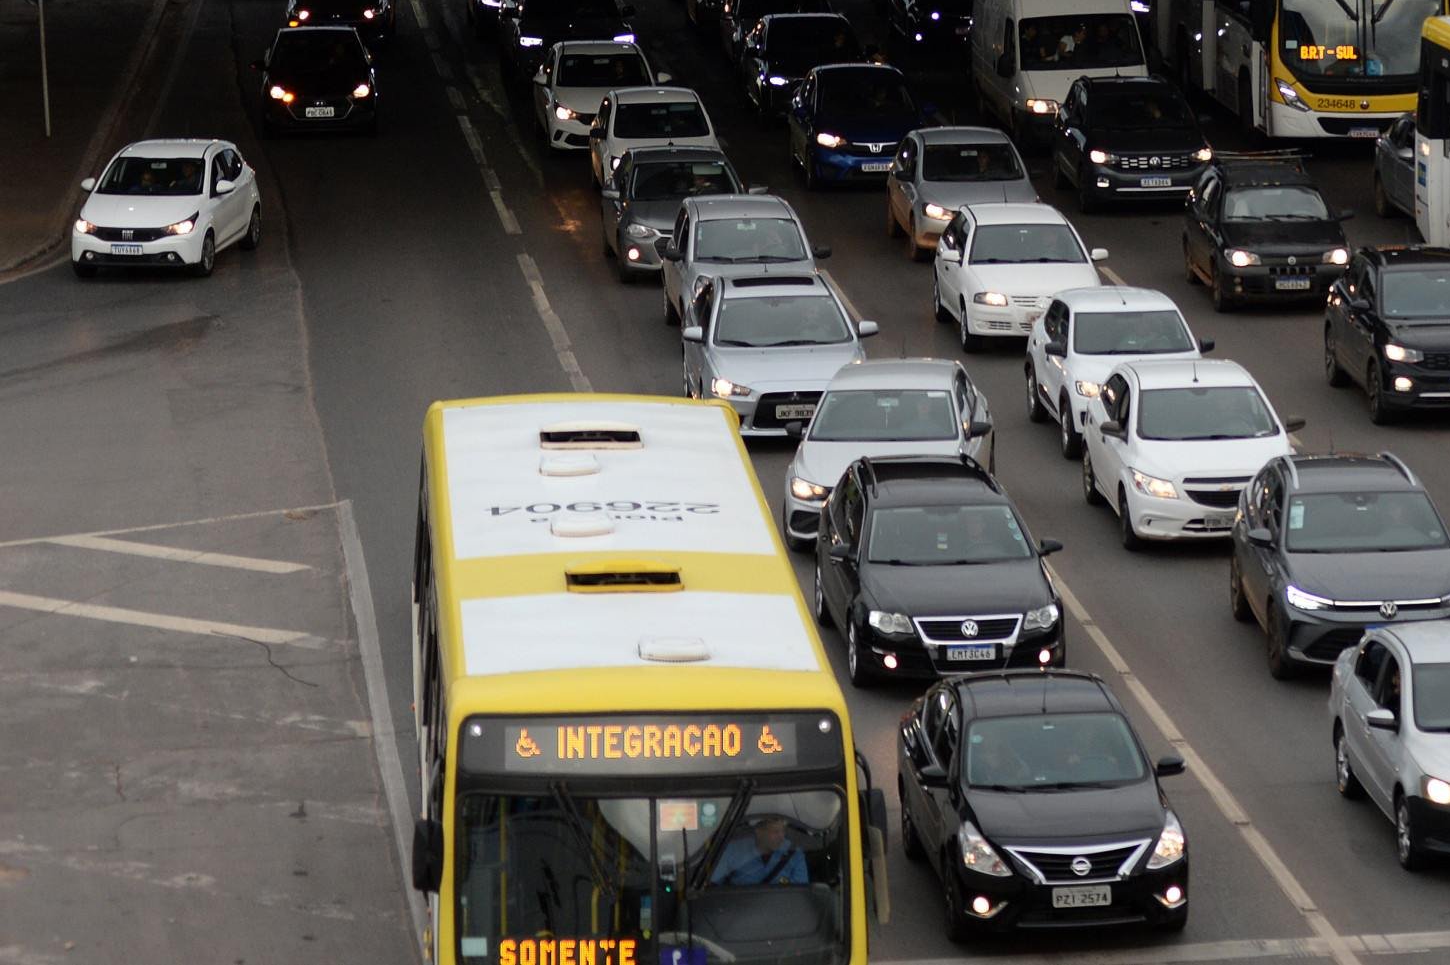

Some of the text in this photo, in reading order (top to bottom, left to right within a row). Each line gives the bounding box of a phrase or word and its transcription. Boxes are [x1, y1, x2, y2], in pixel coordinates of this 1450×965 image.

[1318, 97, 1356, 109] 234648
[484, 500, 721, 517] 226904
[499, 938, 637, 965] SOMENTE
